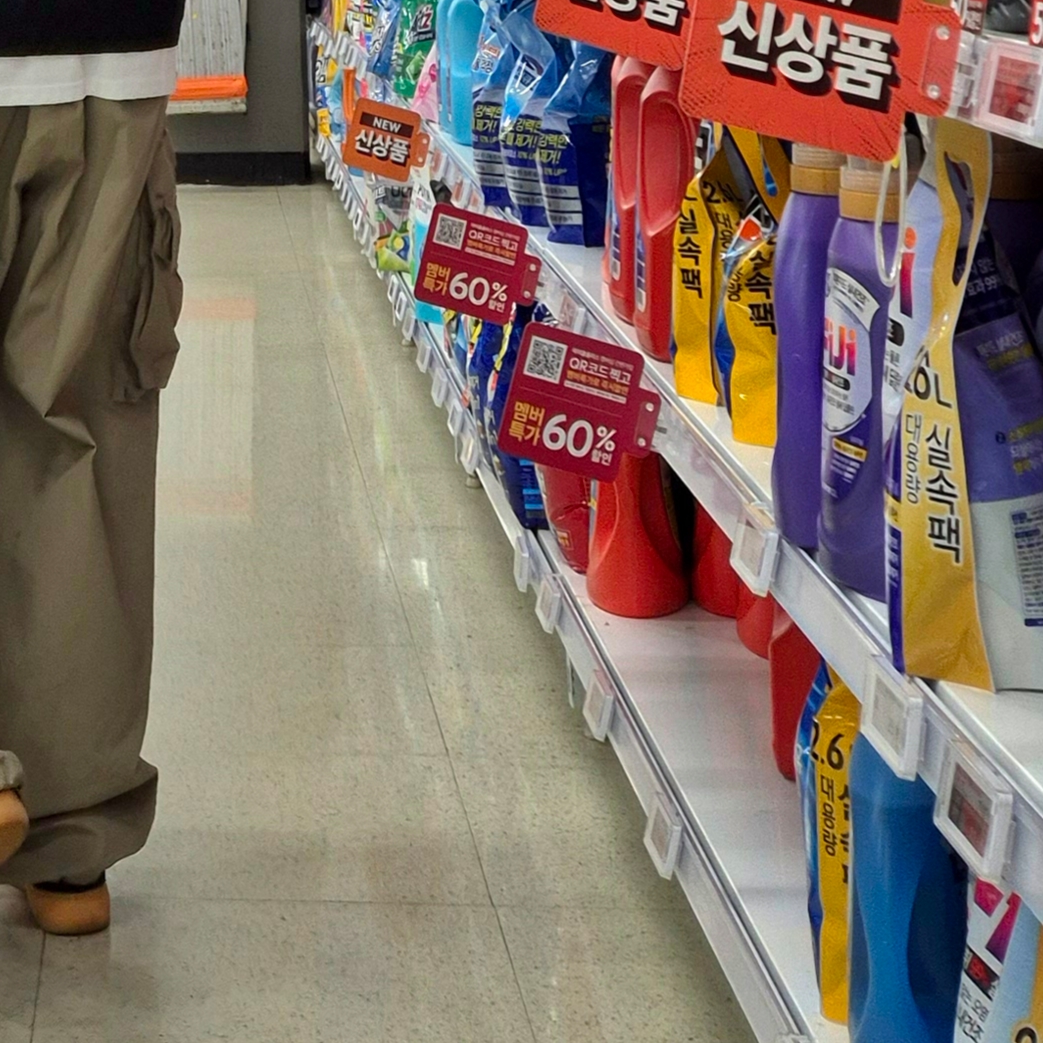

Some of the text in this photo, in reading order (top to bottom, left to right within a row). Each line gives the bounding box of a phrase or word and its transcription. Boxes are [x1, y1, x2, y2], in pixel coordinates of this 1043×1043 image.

[717, 0, 893, 100] 신상품
[372, 116, 401, 133] NEW
[354, 128, 409, 164] 신상품
[449, 271, 509, 306] 60%
[569, 357, 609, 378] QR코드
[609, 367, 632, 386] 찍고
[513, 401, 546, 427] 멤버
[508, 419, 541, 447] 특가
[542, 413, 618, 459] 60%
[591, 448, 614, 467] 할인
[905, 413, 922, 505] 대용량
[925, 422, 961, 565] 실속팩
[820, 774, 836, 857] 대용량
